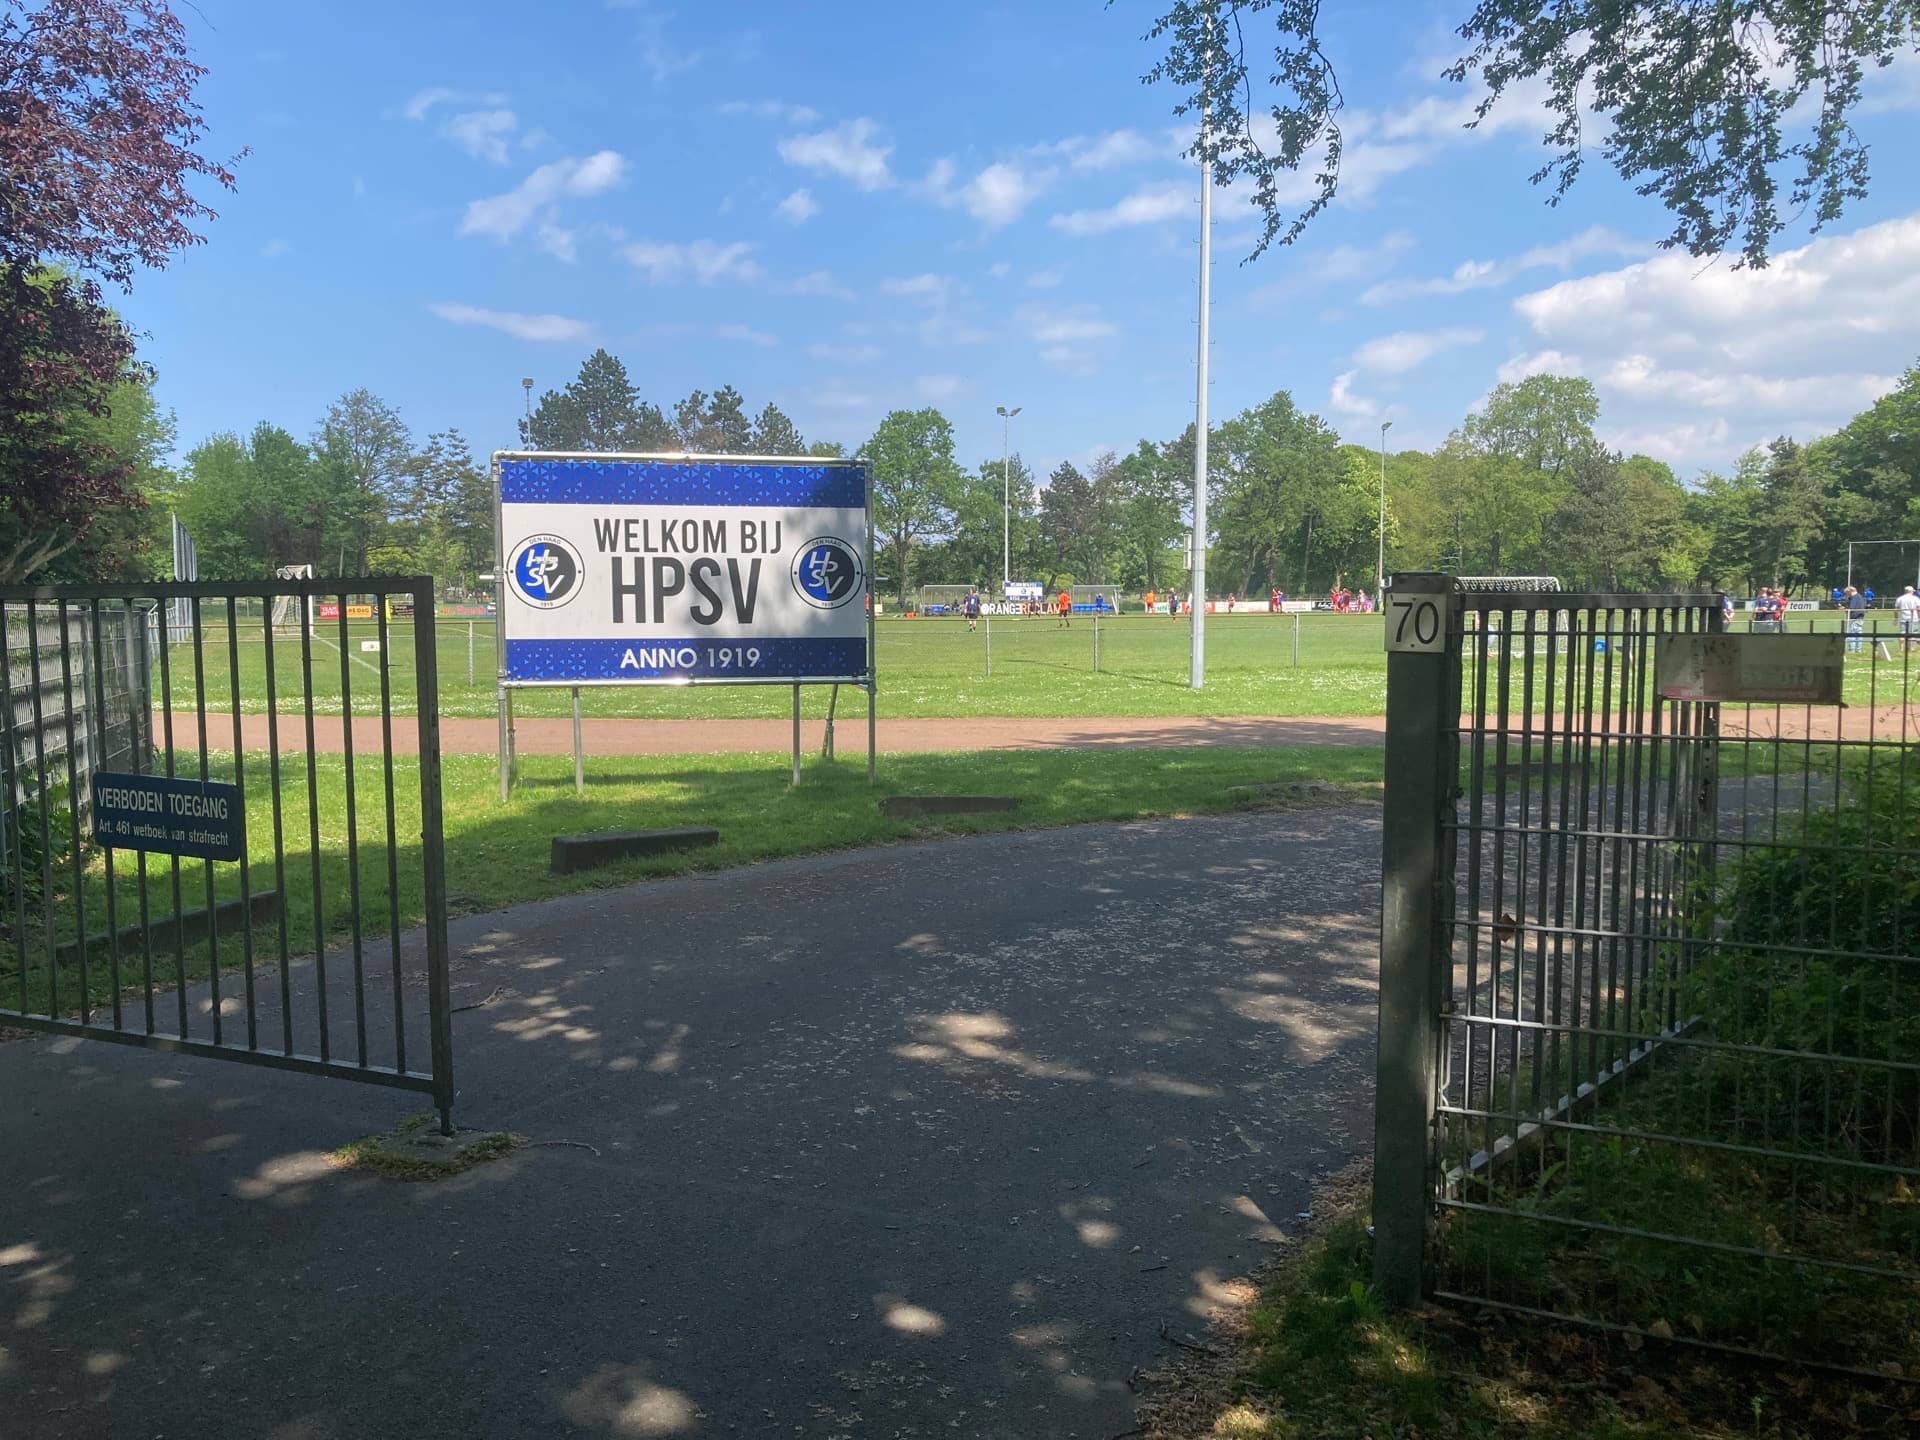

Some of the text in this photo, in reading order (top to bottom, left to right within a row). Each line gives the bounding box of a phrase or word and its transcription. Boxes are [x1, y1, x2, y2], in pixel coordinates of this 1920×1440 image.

[593, 518, 781, 555] WELKOM BIJ
[611, 556, 762, 626] HPSV
[1789, 602, 1812, 610] team
[1392, 601, 1439, 644] 70
[620, 647, 761, 669] ANNO 1919
[97, 787, 228, 819] VERBODEN TOEGANG
[99, 819, 229, 846] Art. 461 wetboek van strafrecht
